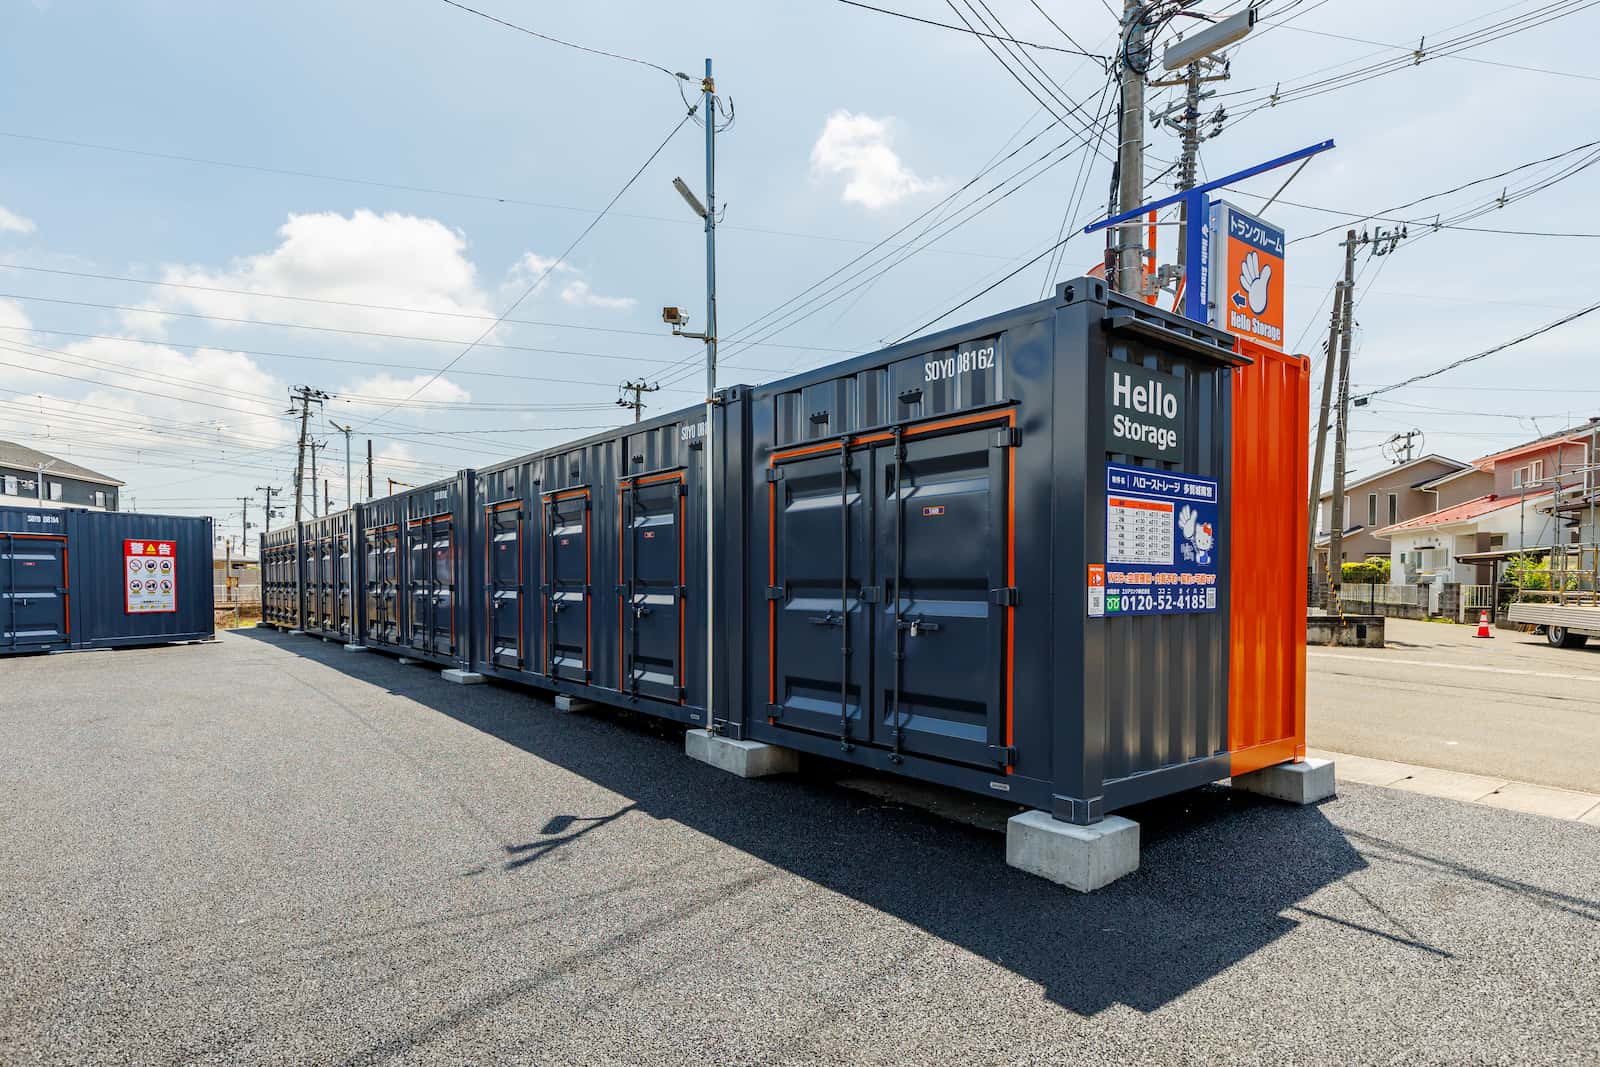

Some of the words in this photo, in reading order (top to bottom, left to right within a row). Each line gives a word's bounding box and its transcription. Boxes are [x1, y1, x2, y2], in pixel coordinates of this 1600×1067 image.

[1231, 216, 1283, 253] トランクルーム
[1231, 310, 1251, 332] Hello
[1252, 317, 1281, 341] Storage
[957, 347, 994, 374] 08162
[1113, 372, 1177, 419] Hello
[1113, 414, 1177, 450] Storage
[1132, 476, 1181, 493] ハローストレージ
[1121, 595, 1206, 611] 0120-52-4185
